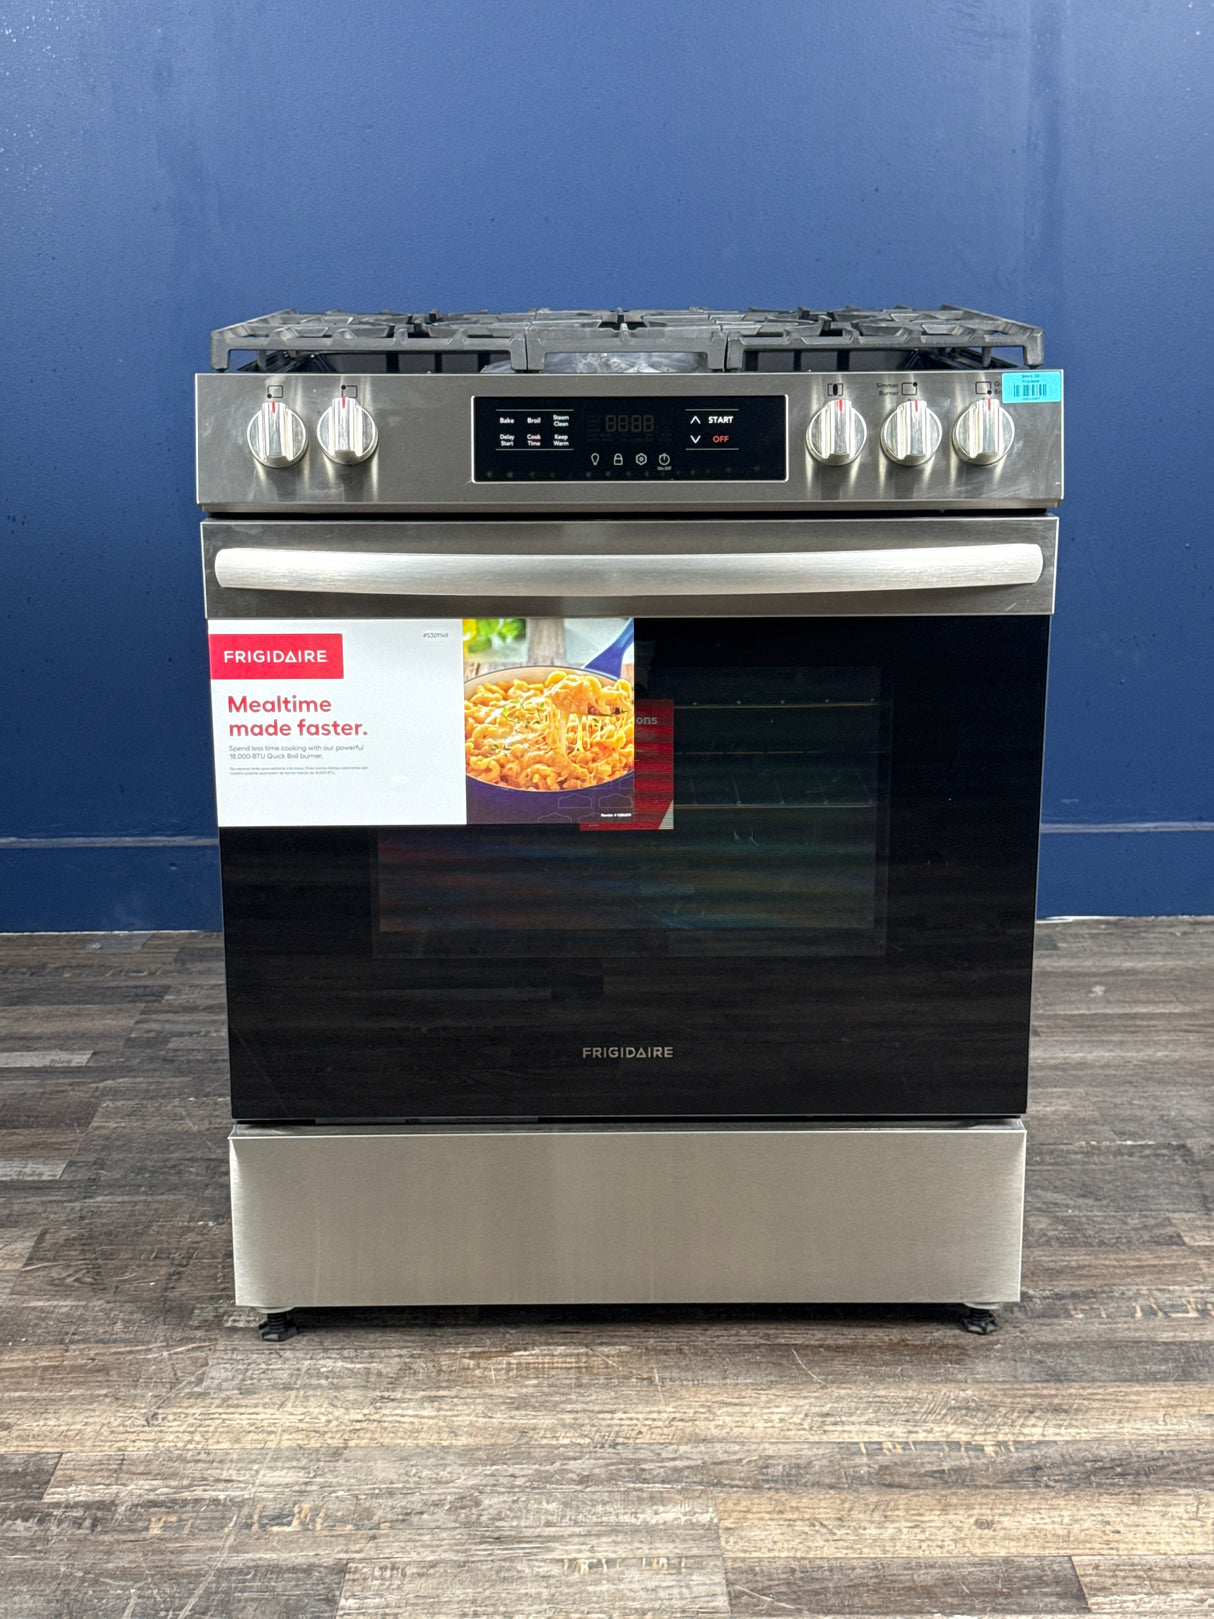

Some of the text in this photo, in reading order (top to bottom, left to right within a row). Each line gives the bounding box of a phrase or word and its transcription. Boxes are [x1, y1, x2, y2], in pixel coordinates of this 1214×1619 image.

[708, 415, 734, 424] START
[499, 433, 515, 442] Delay
[554, 433, 569, 441] Keep
[712, 434, 730, 443] OFF
[223, 650, 328, 663] FRIGIDAIRE
[227, 695, 332, 713] Mealtime
[635, 716, 658, 725] ons
[229, 718, 368, 737] made faster.
[335, 744, 365, 752] powerful
[582, 1046, 674, 1059] FRIGIDAIRE
